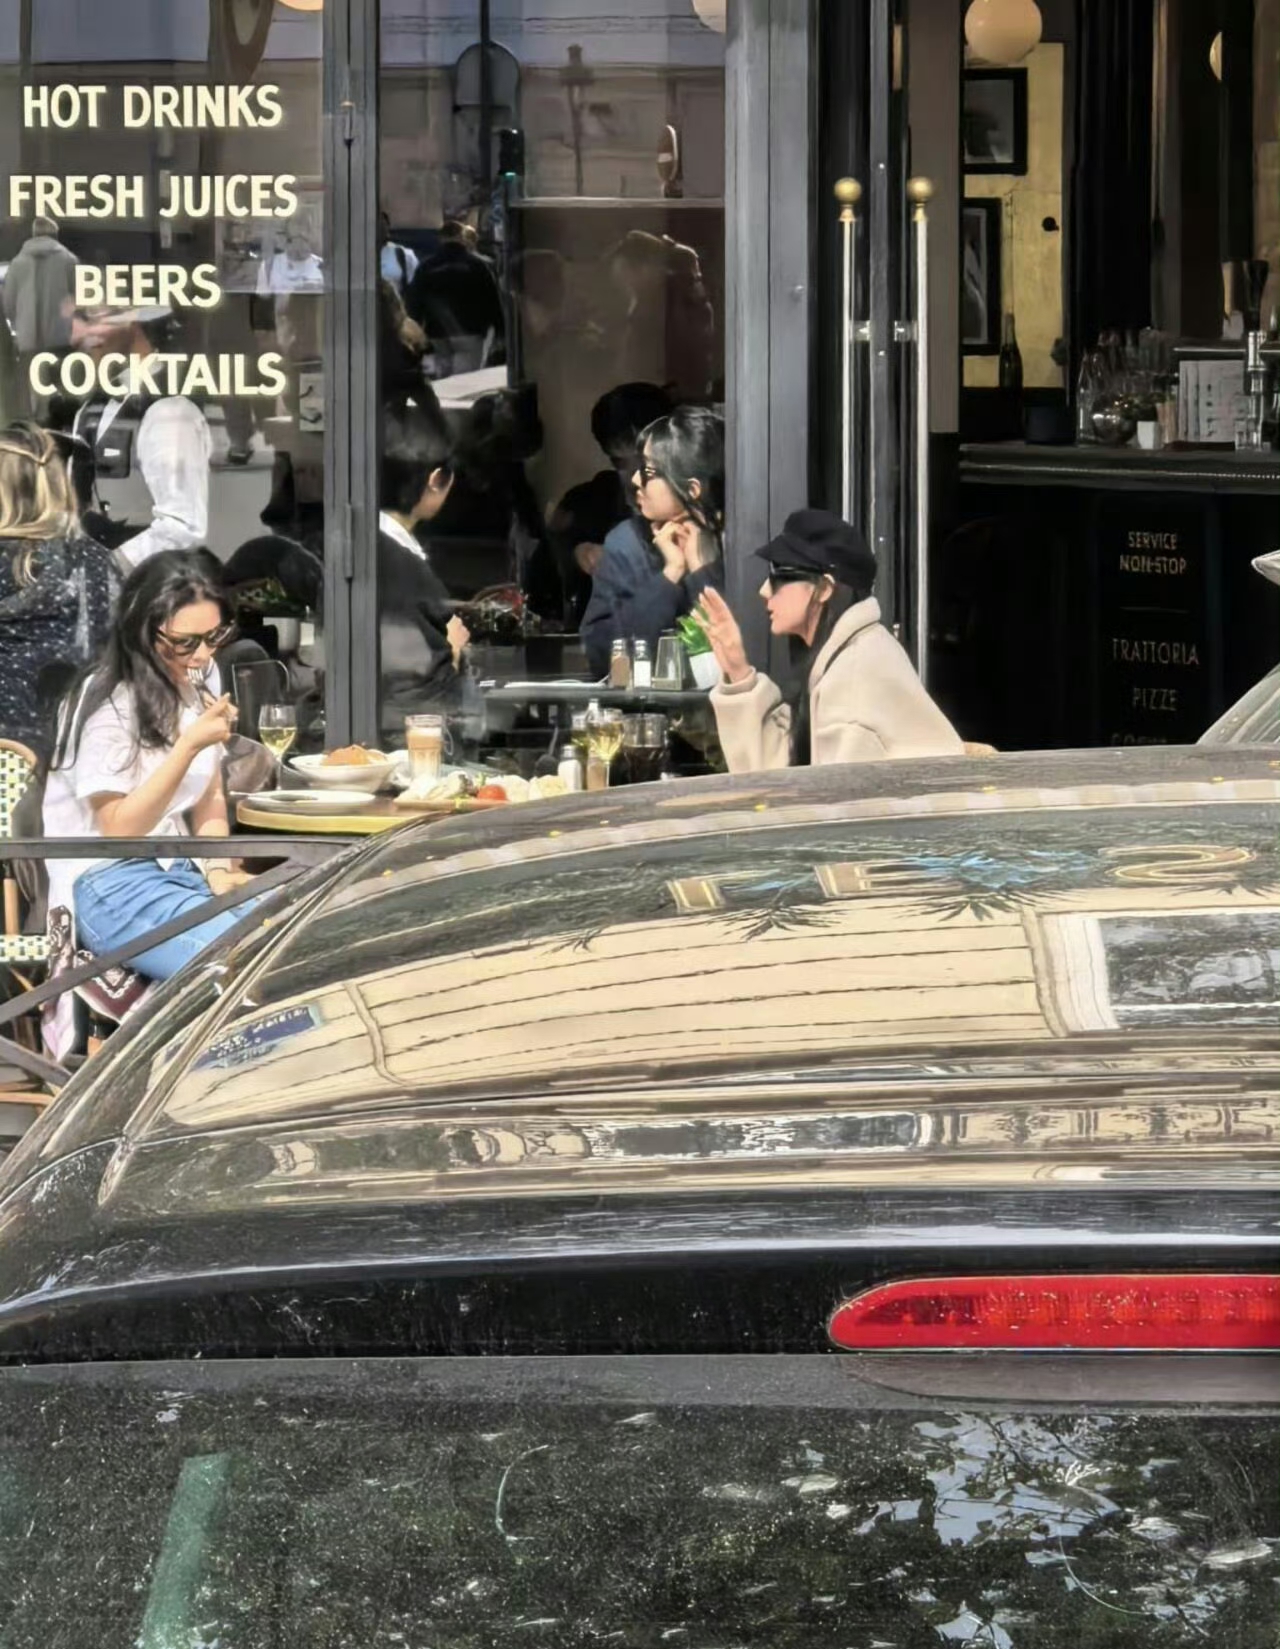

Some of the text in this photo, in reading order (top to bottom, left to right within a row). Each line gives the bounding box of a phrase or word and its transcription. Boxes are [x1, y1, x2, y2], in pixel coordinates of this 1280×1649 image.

[23, 84, 283, 128] HOT DRINKS
[9, 174, 298, 218] FRESH JUICES
[75, 263, 222, 308] BEERS
[29, 352, 287, 397] COCKTAILS
[1128, 531, 1178, 550] SERVICE
[1112, 637, 1200, 665] TRATTORIA
[1132, 687, 1177, 711] PIZZE
